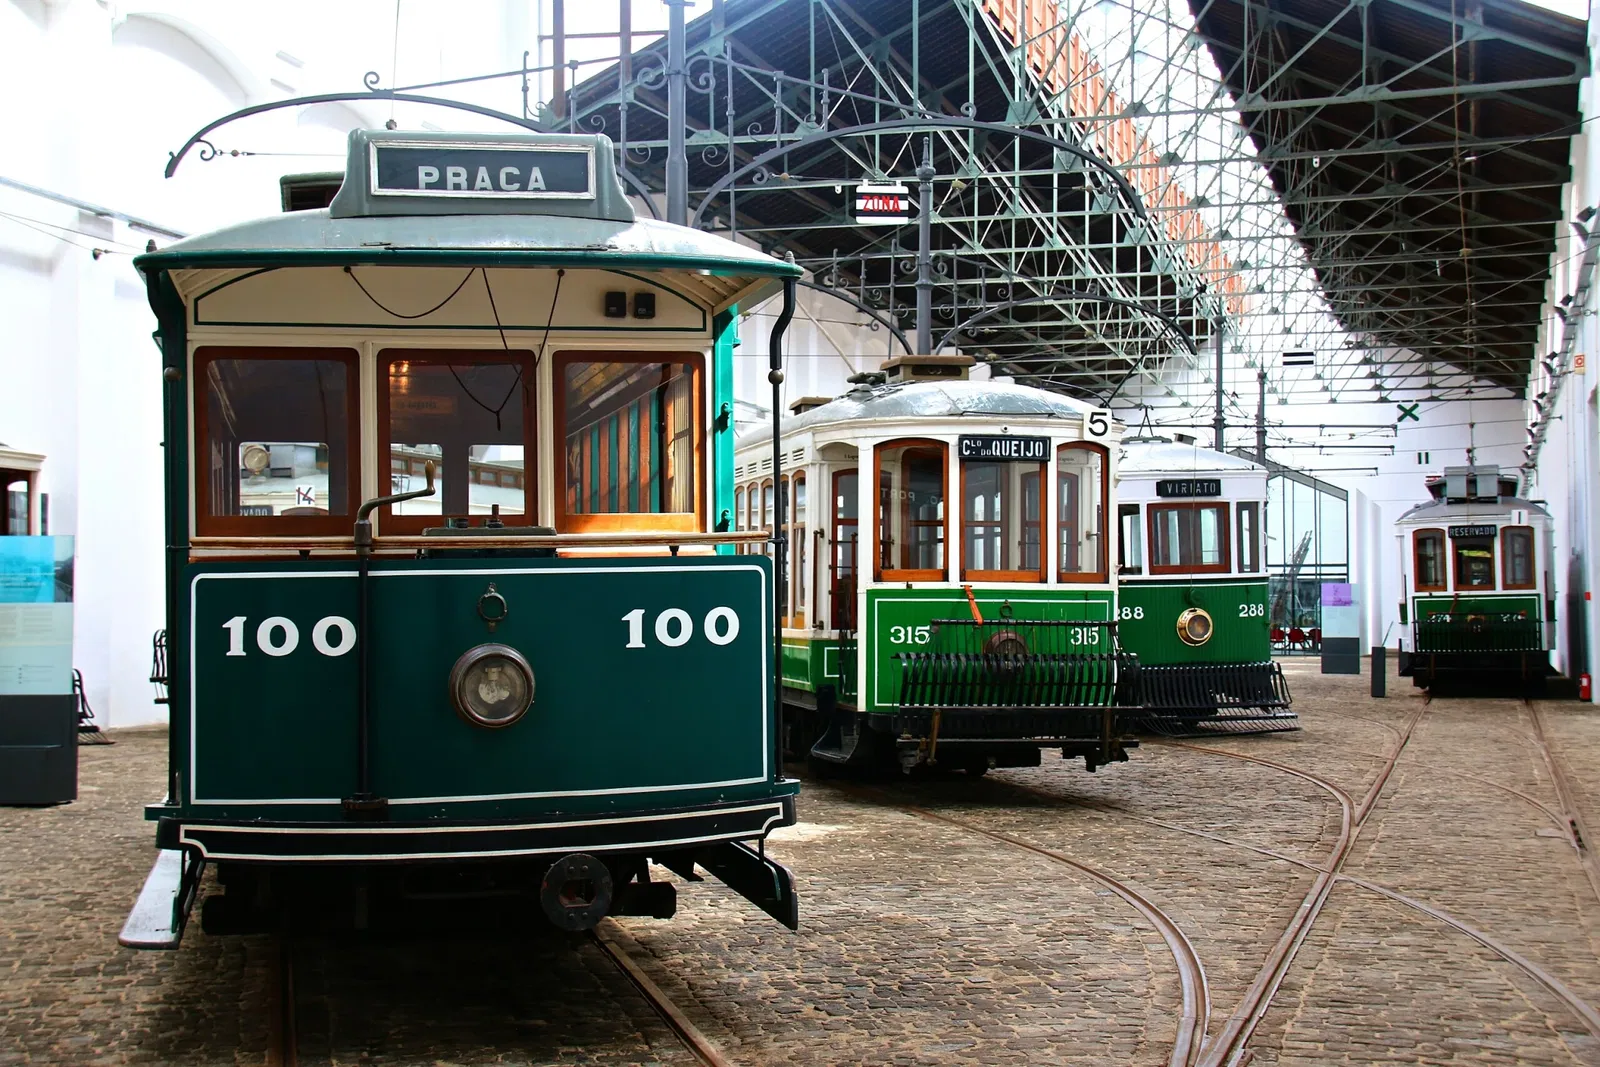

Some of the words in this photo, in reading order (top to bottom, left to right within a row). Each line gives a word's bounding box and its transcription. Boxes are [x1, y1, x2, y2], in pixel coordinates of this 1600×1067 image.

[862, 195, 901, 212] ZONA
[1088, 411, 1109, 437] 5
[991, 440, 1043, 457] QUEIJO
[1166, 482, 1217, 494] VIRIATO
[1449, 526, 1496, 537] RESERVADO
[1118, 606, 1145, 620] 88
[1238, 603, 1265, 618] 288
[221, 615, 357, 657] 100
[620, 606, 741, 649] 100
[889, 625, 931, 645] 315
[1070, 626, 1099, 646] 315
